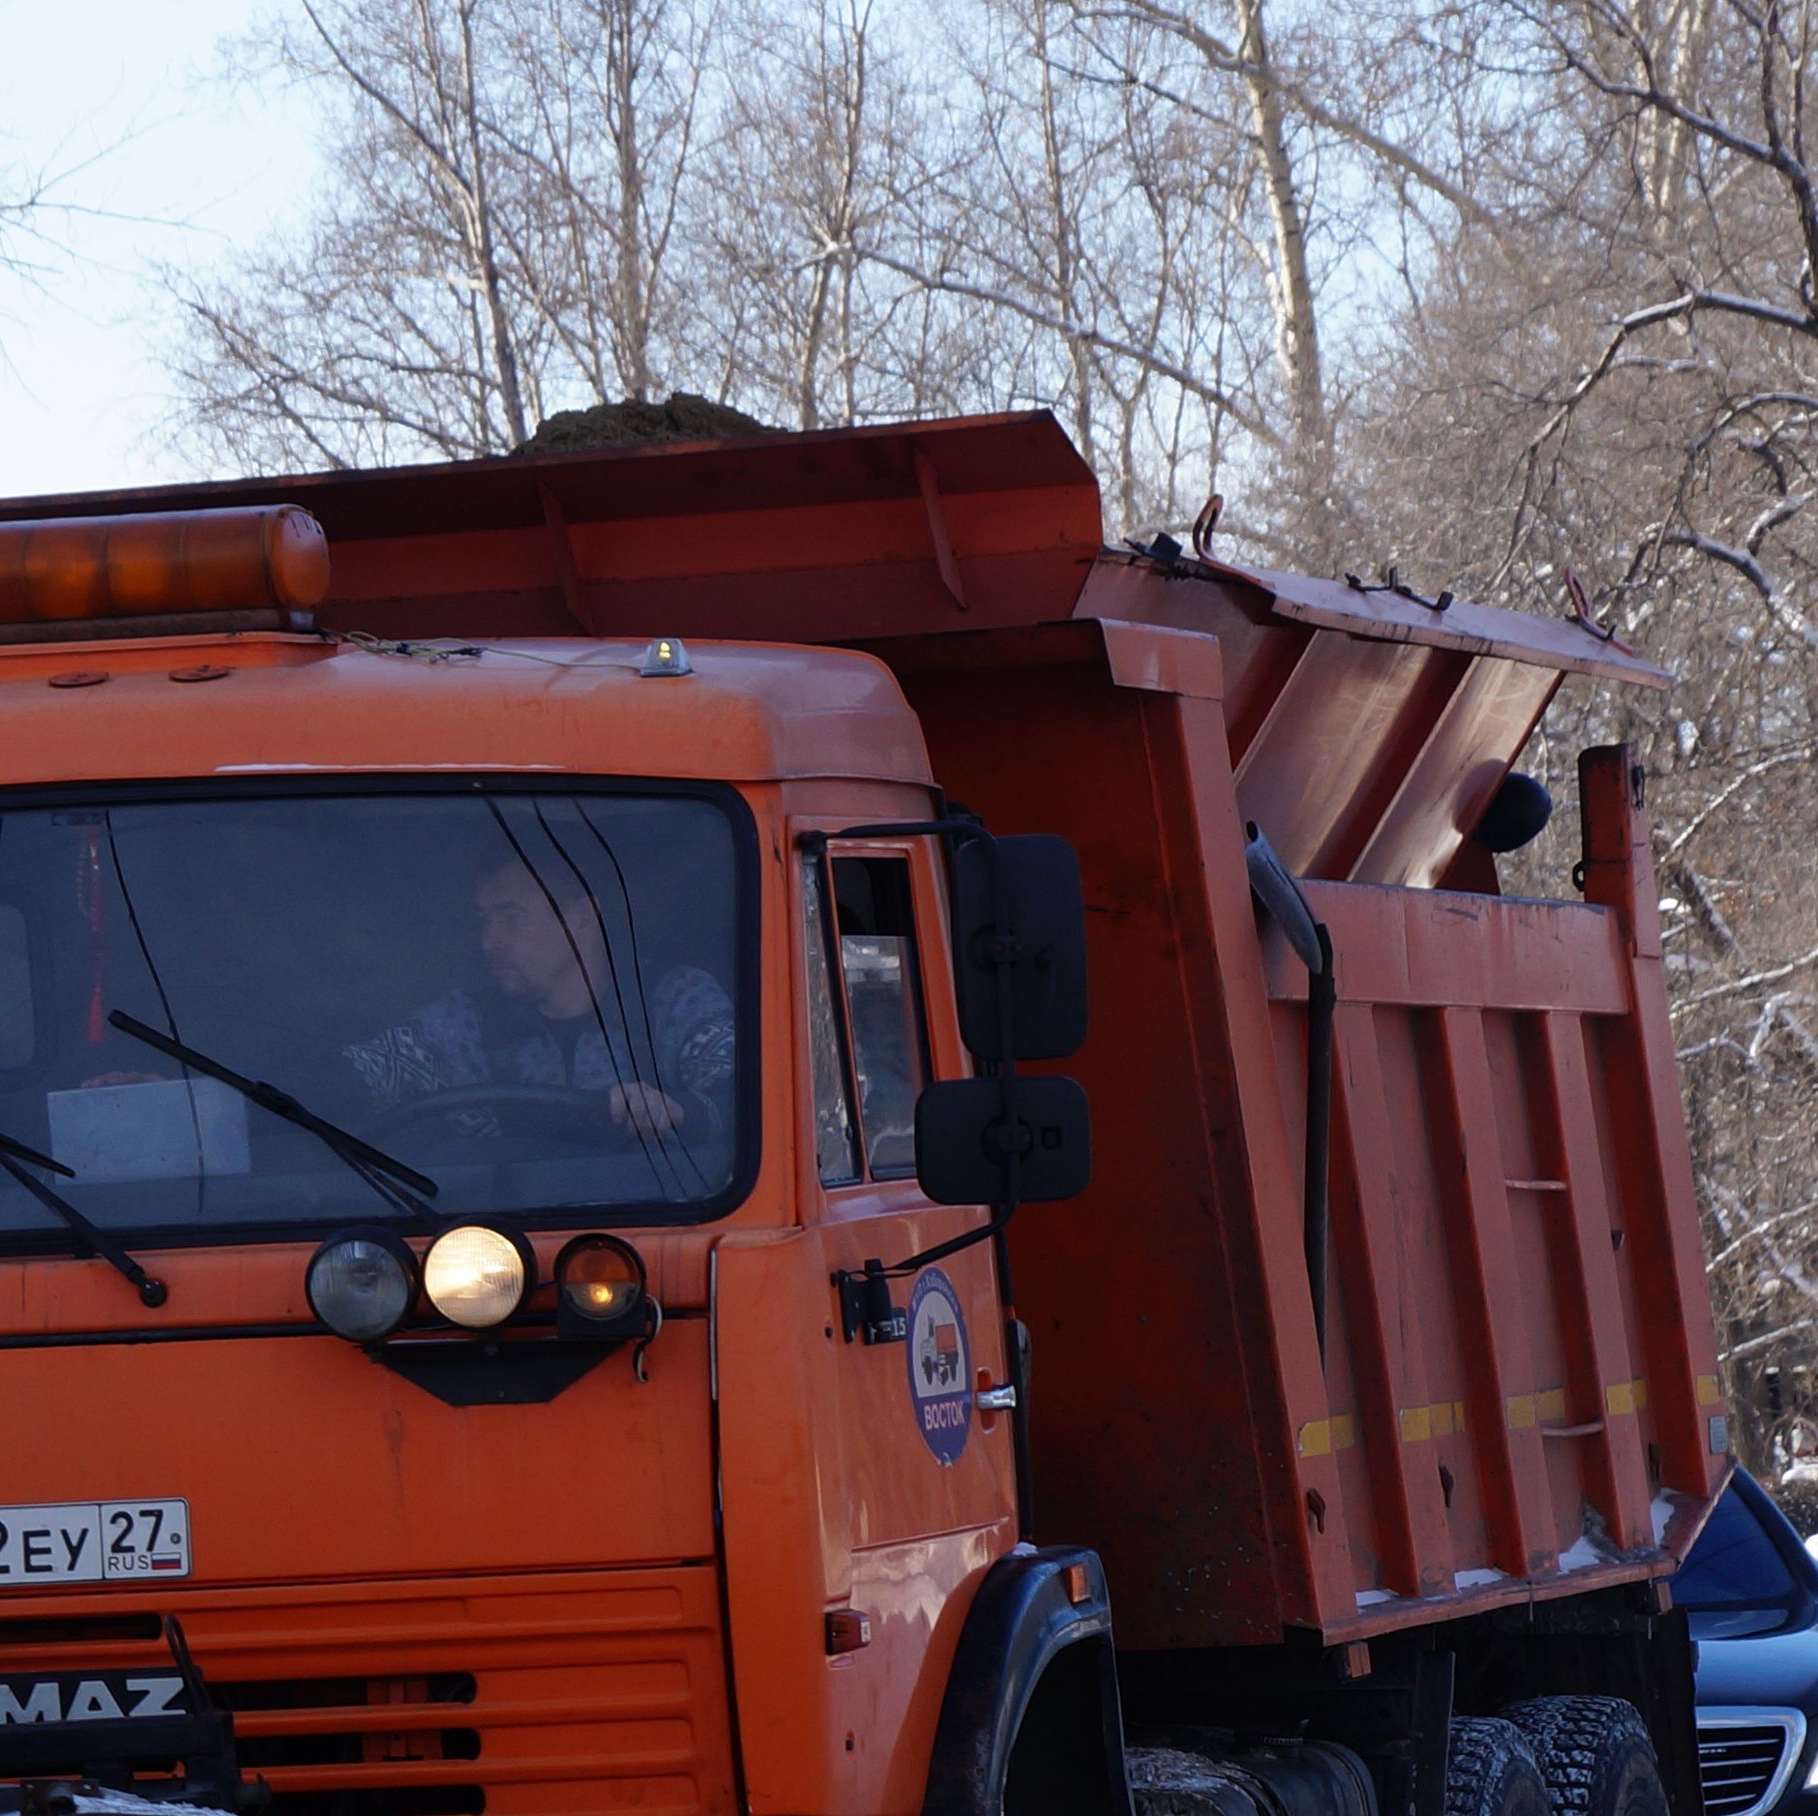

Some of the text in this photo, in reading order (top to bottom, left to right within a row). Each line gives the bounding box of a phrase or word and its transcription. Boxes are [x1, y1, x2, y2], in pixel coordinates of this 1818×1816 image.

[923, 1399, 965, 1431] ВОСТОК
[108, 1508, 164, 1554] 27
[108, 1553, 149, 1571] RUS
